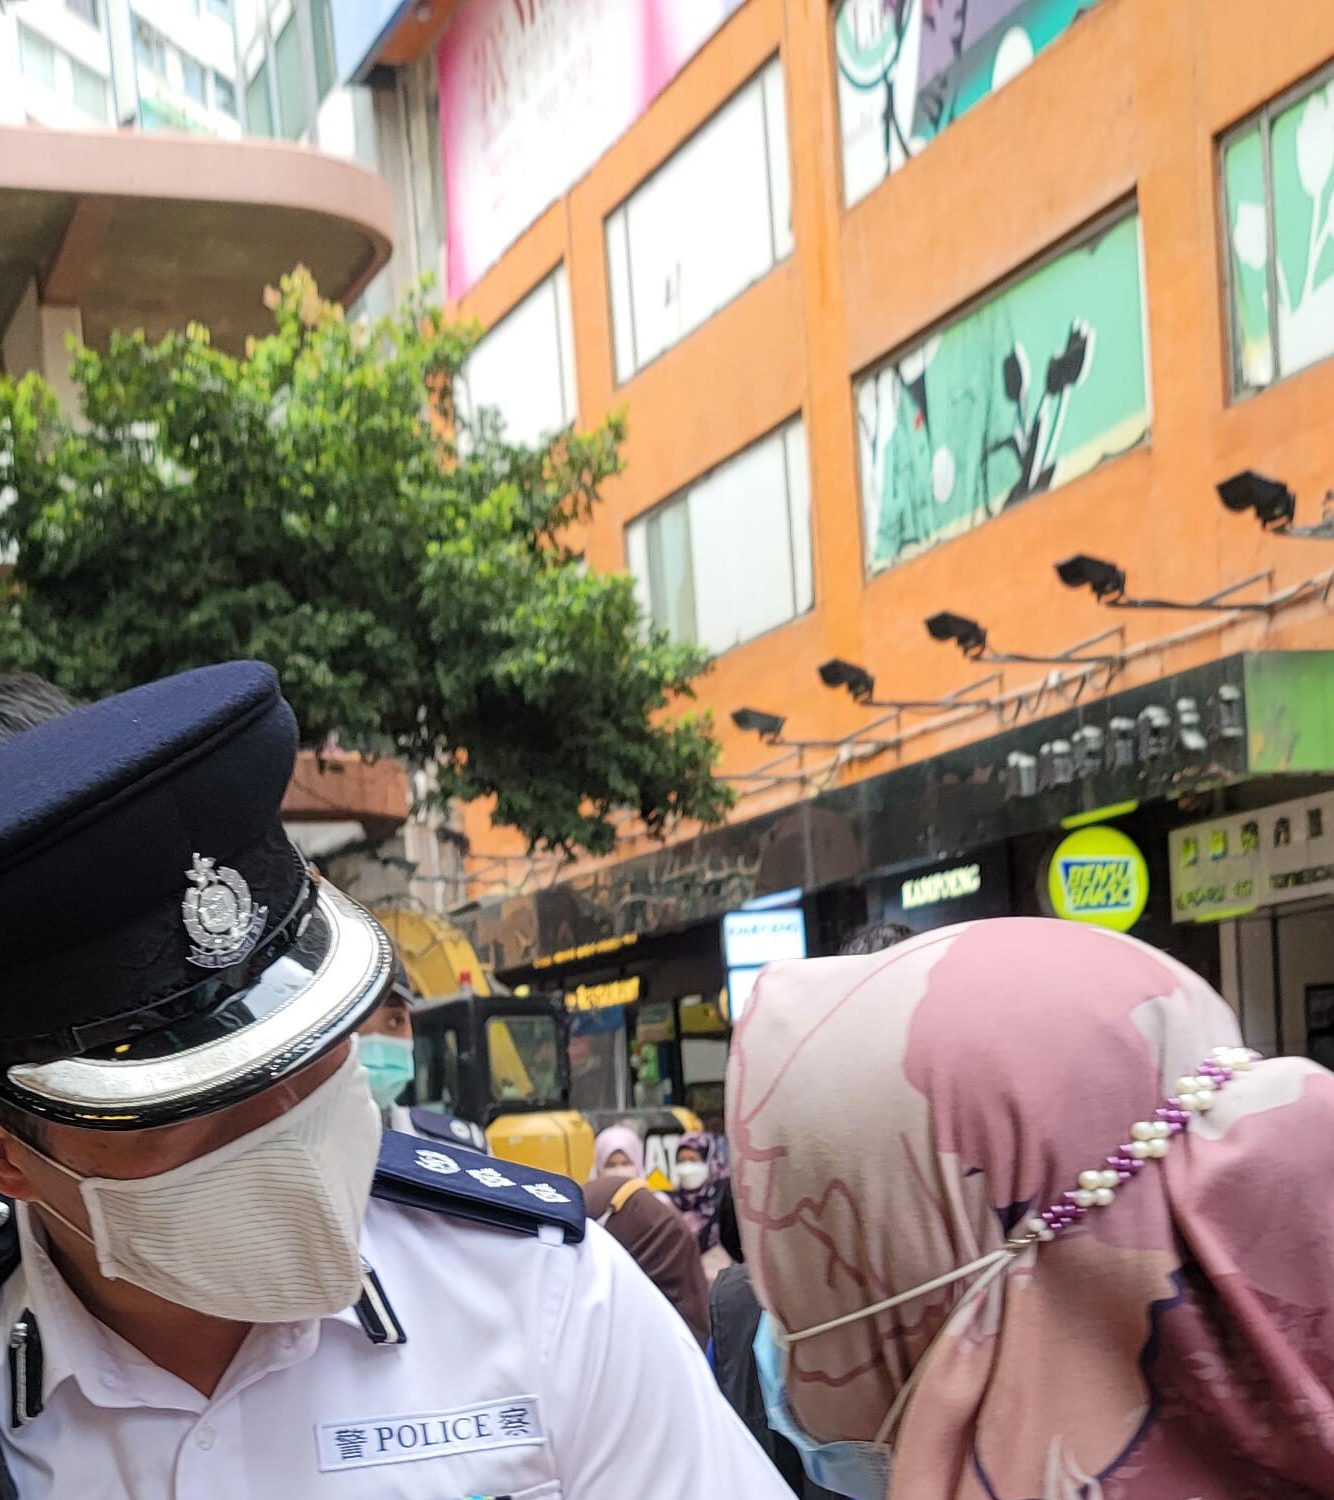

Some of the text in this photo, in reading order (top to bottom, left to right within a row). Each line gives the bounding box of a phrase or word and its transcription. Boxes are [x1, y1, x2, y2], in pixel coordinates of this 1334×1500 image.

[645, 1133, 683, 1190] AT
[374, 1413, 493, 1453] POLICE
[498, 1406, 530, 1437] 察
[334, 1428, 368, 1461] 警
